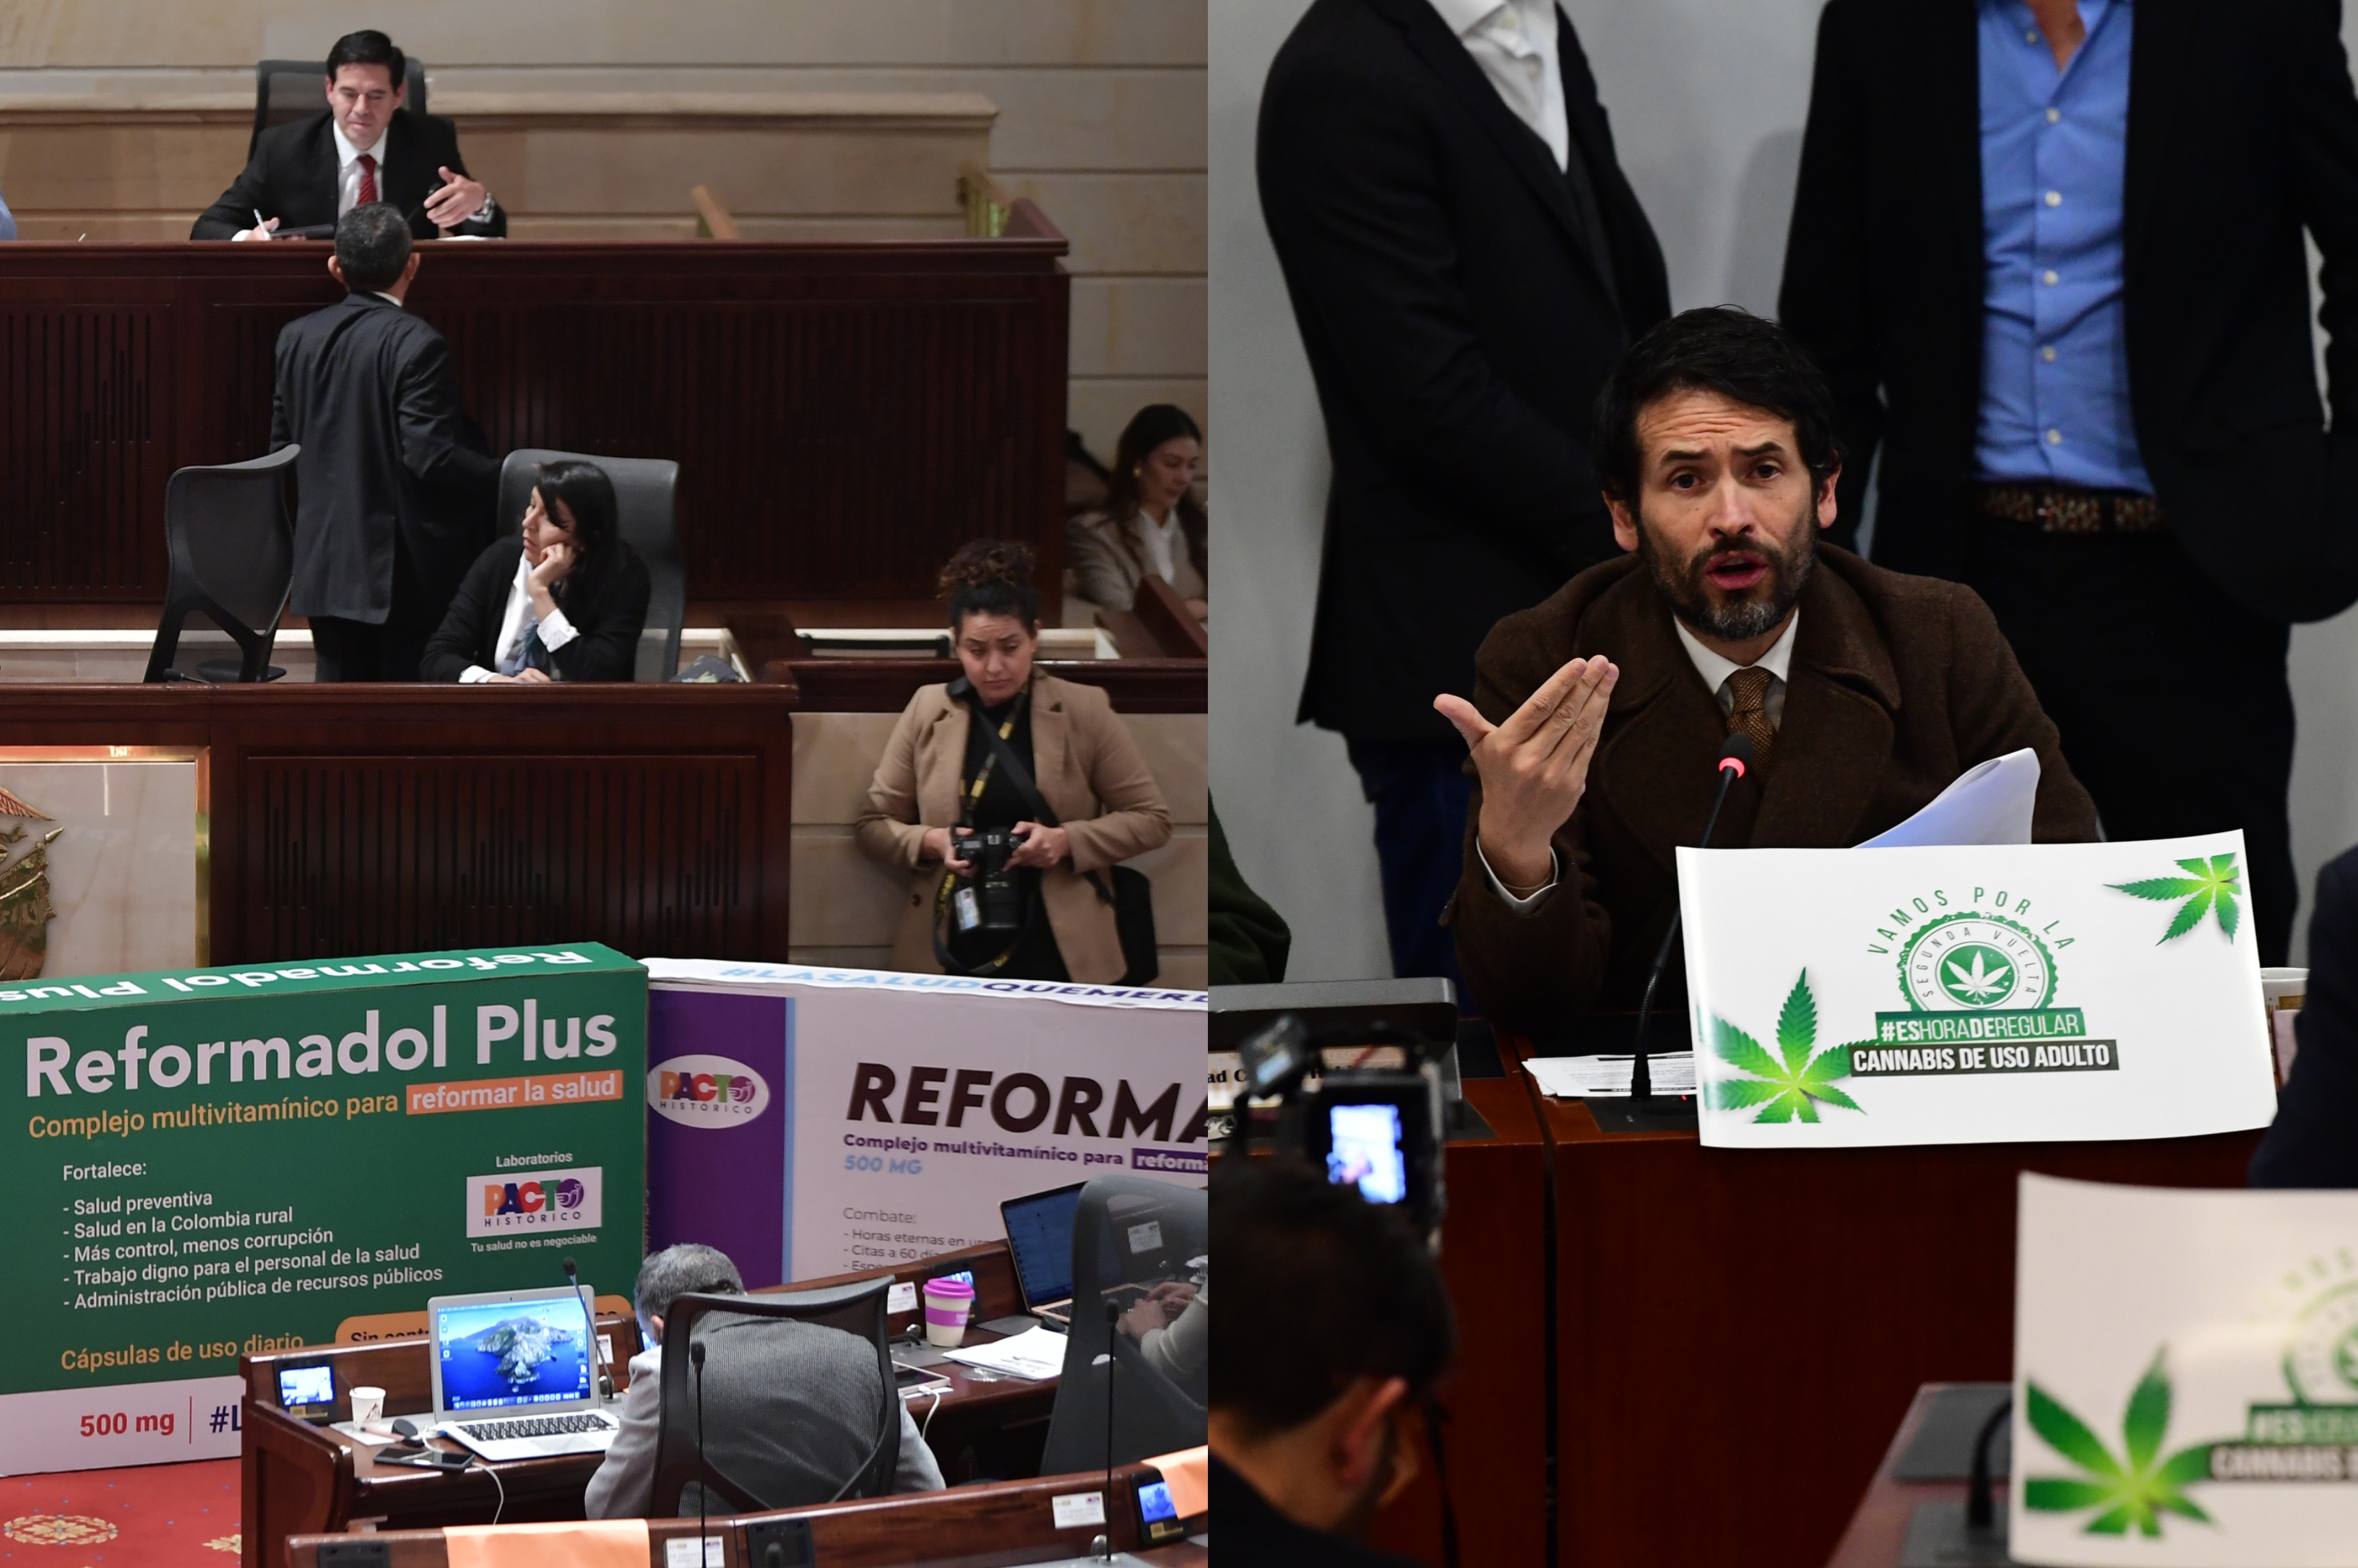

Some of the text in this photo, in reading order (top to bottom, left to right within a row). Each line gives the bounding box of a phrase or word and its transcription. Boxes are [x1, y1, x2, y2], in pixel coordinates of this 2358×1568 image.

[1867, 887, 2075, 954] VAMOS POR LA
[0, 951, 592, 1002] Reformadol Plus
[1916, 927, 2039, 998] SEGUNDA VUELTA
[1880, 1014, 2080, 1042] #ESHORADEREGULAR
[27, 999, 618, 1097] Reformadol Plus
[1853, 1044, 2110, 1072] CANNABIS DE USO ADULTO
[660, 1070, 755, 1104] PACTO
[29, 1073, 615, 1140] Complejo multivitamínico para reformar la salud
[496, 1151, 573, 1168] Laboratorios
[843, 1133, 928, 1154] Complejo
[933, 1140, 1078, 1162] multivitamínico
[1084, 1153, 1123, 1166] para
[844, 1156, 923, 1175] 500 MG
[63, 1161, 147, 1181] Fortalece:
[74, 1191, 212, 1215] Salud preventiva
[484, 1178, 584, 1217] PACTO
[74, 1205, 293, 1239] Salud en la Colombia rural
[843, 1207, 916, 1224] Combate:
[74, 1227, 333, 1262] Más control, menos corrupción
[471, 1242, 484, 1252] Tu
[485, 1240, 513, 1252] salud
[530, 1239, 541, 1248] es
[543, 1234, 597, 1248] negociable
[851, 1244, 885, 1257] Citas
[888, 1249, 896, 1257] a
[899, 1248, 917, 1259] 60
[852, 1229, 891, 1242] Horas
[894, 1233, 944, 1246] eternas
[948, 1237, 964, 1247] en
[74, 1243, 420, 1286] Trabajo digno para el personal de la salud
[74, 1267, 443, 1309] Administración pública de recursos públicos
[61, 1332, 303, 1372] Cápsulas de uso diario
[80, 1412, 128, 1437] 500
[135, 1413, 175, 1436] mg
